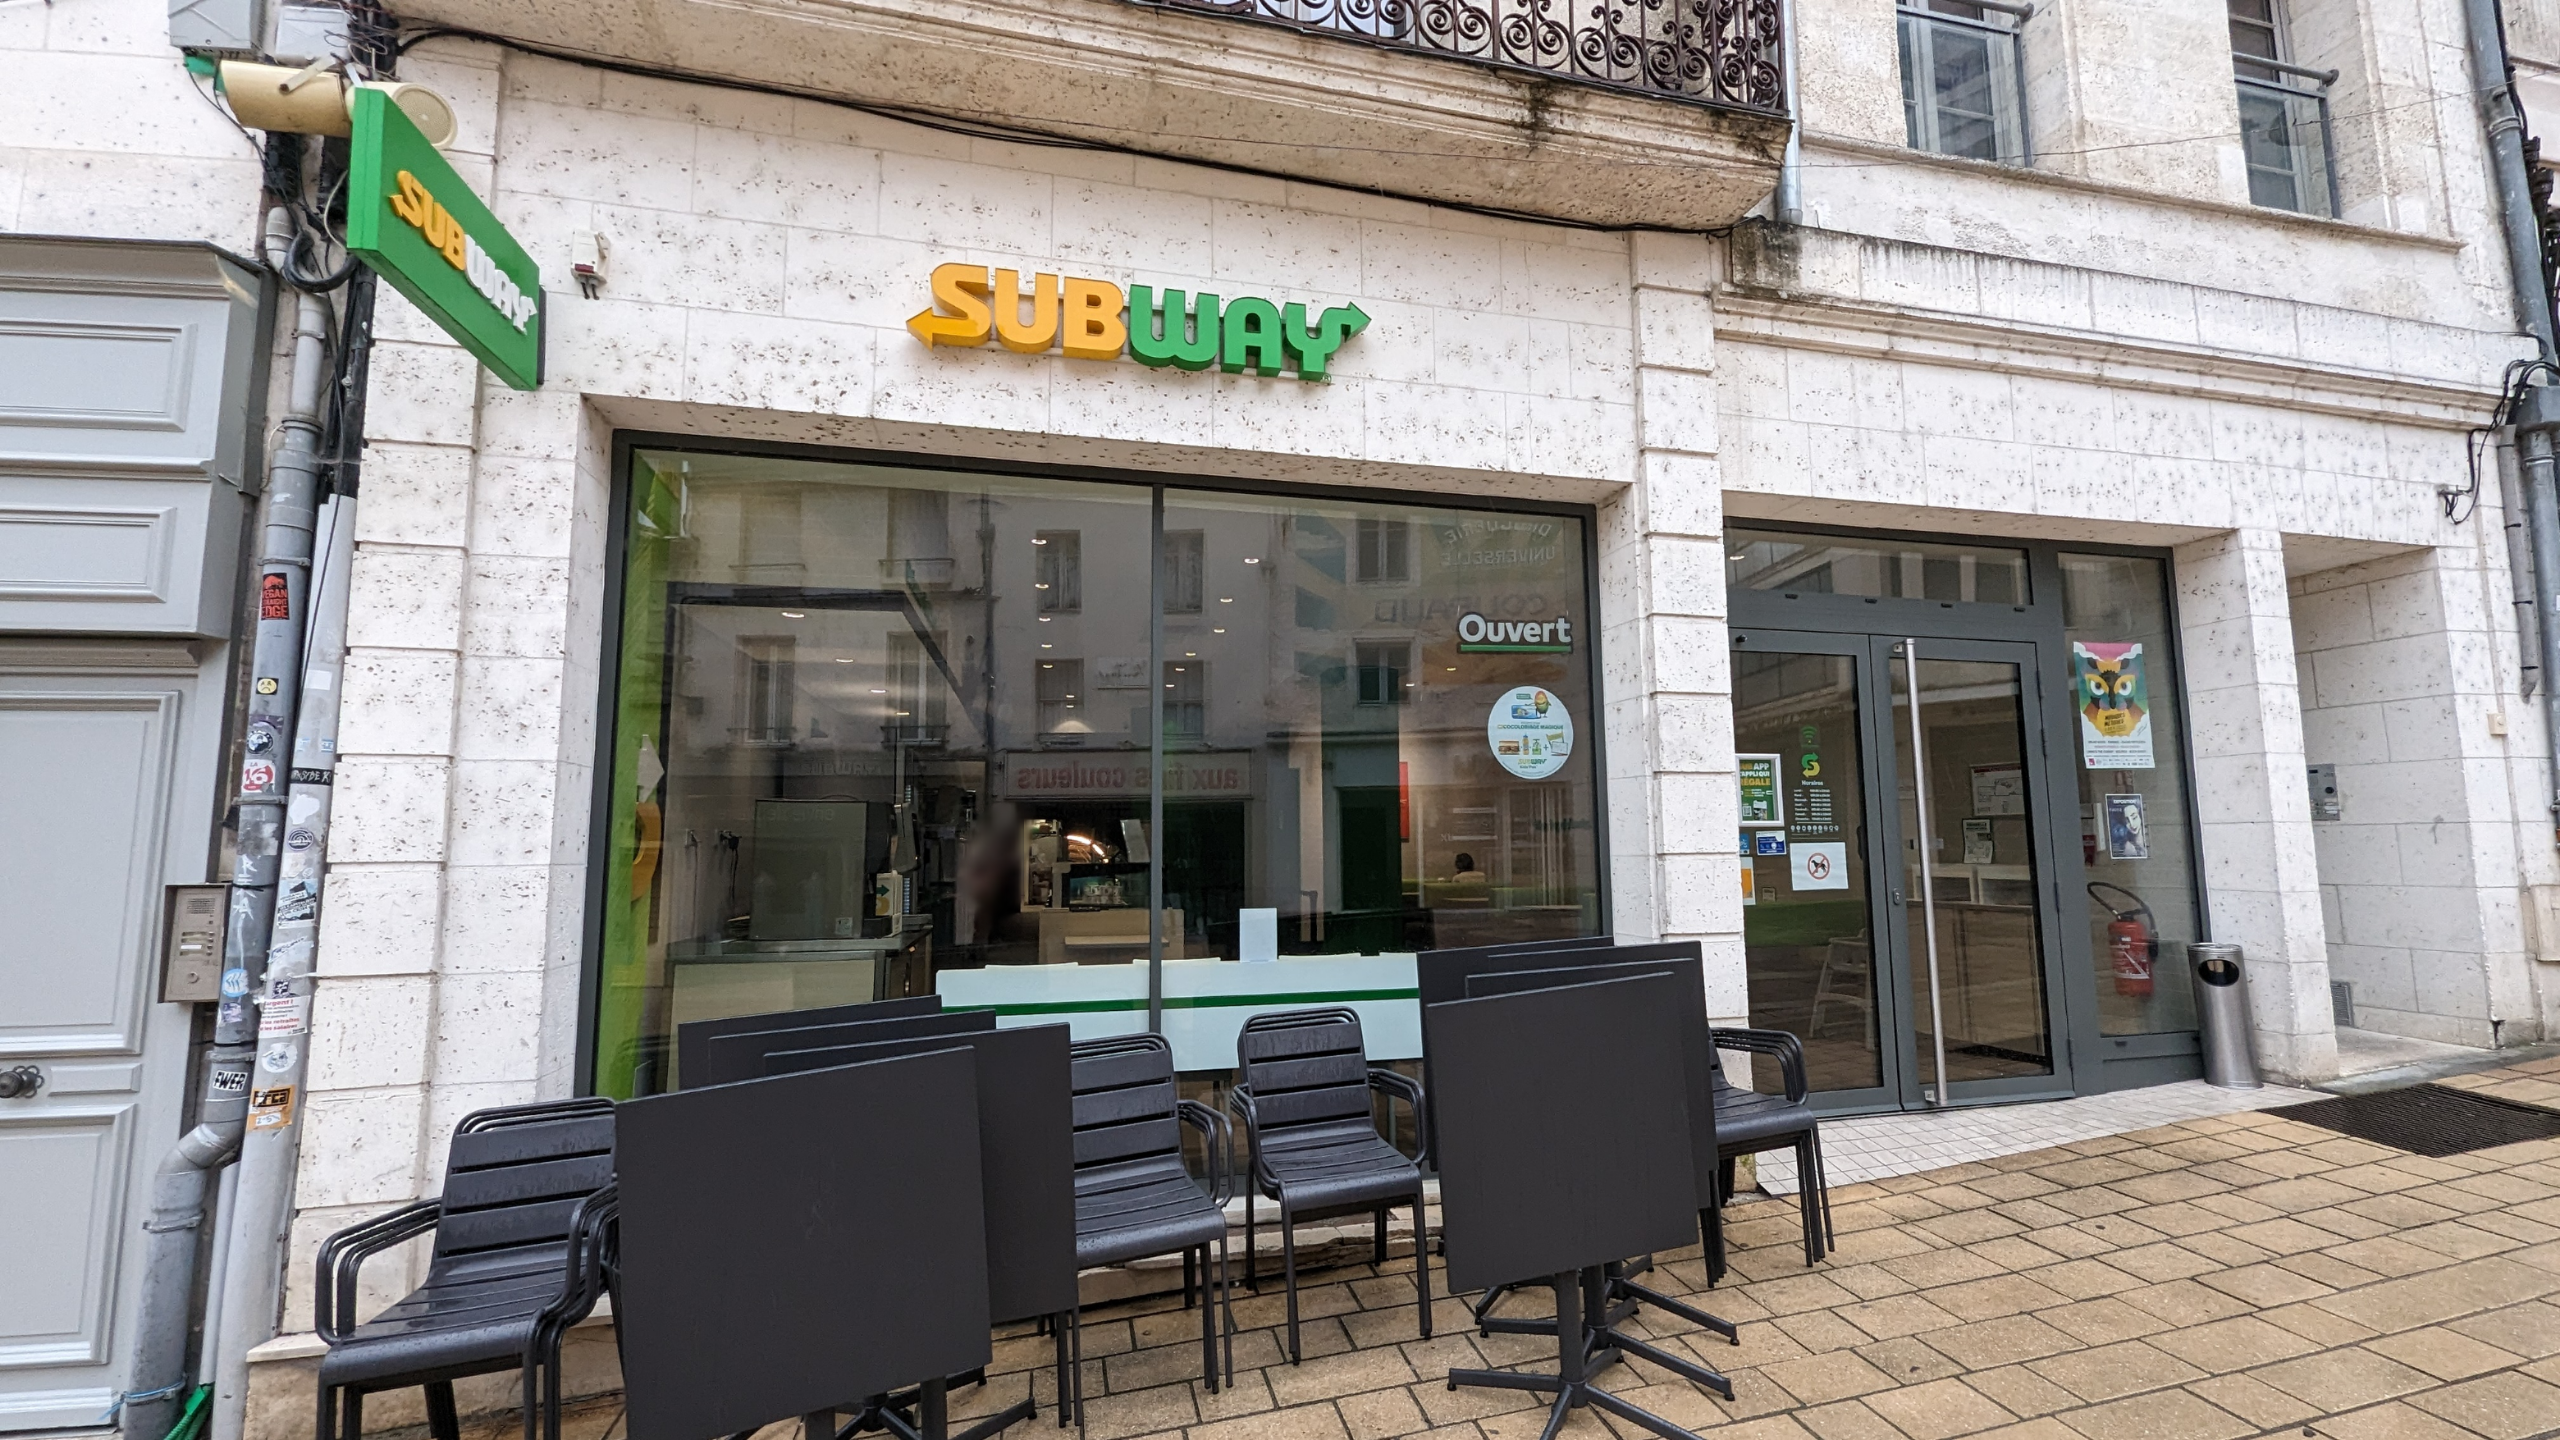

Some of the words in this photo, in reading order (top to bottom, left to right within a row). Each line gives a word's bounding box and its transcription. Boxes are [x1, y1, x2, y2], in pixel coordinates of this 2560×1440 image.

[389, 170, 537, 335] SUBWAY
[906, 262, 1372, 383] SUBWAY
[1458, 613, 1571, 643] Ouvert
[1753, 762, 1770, 770] APP
